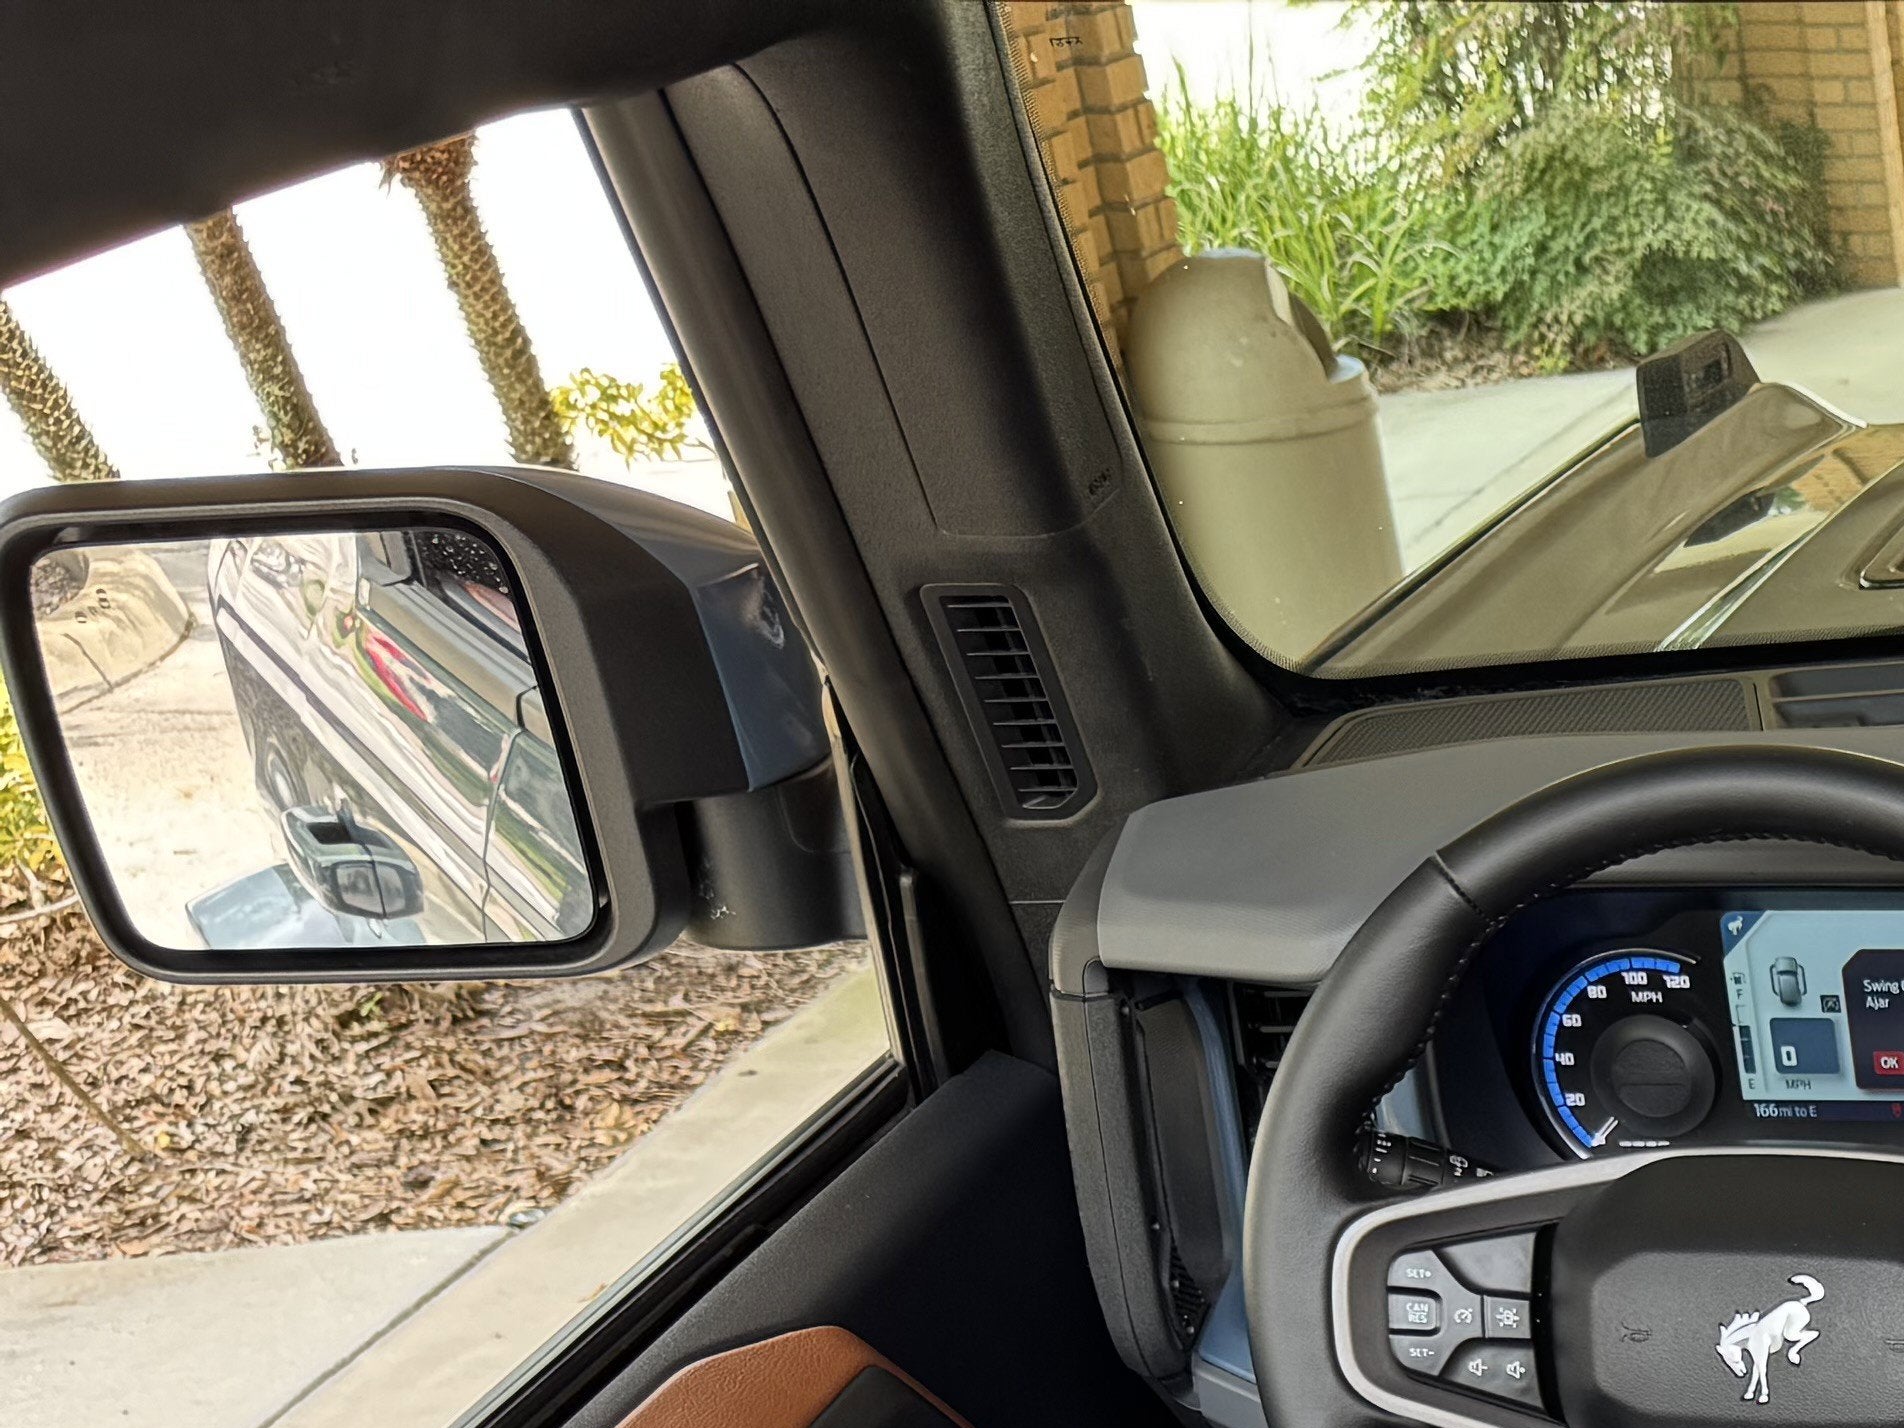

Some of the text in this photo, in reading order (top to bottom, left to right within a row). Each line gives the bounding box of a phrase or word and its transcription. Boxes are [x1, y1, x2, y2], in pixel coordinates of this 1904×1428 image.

[1621, 971, 1648, 985] 100
[1662, 974, 1691, 989] 120
[1587, 985, 1607, 999] 80
[1736, 988, 1744, 999] F
[1862, 979, 1900, 995] Swing
[1630, 991, 1664, 1003] MPH
[1865, 996, 1890, 1010] Ajar
[1561, 1013, 1582, 1027] 60
[1554, 1052, 1575, 1065] 40
[1780, 1045, 1798, 1067] 0
[1879, 1056, 1899, 1069] OK
[1748, 1078, 1755, 1090] E
[1785, 1079, 1812, 1090] MPH
[1564, 1092, 1586, 1106] 20
[1794, 1105, 1808, 1118] to
[1808, 1104, 1818, 1118] E
[1405, 1302, 1428, 1313] CAN
[1407, 1313, 1428, 1324] RES
